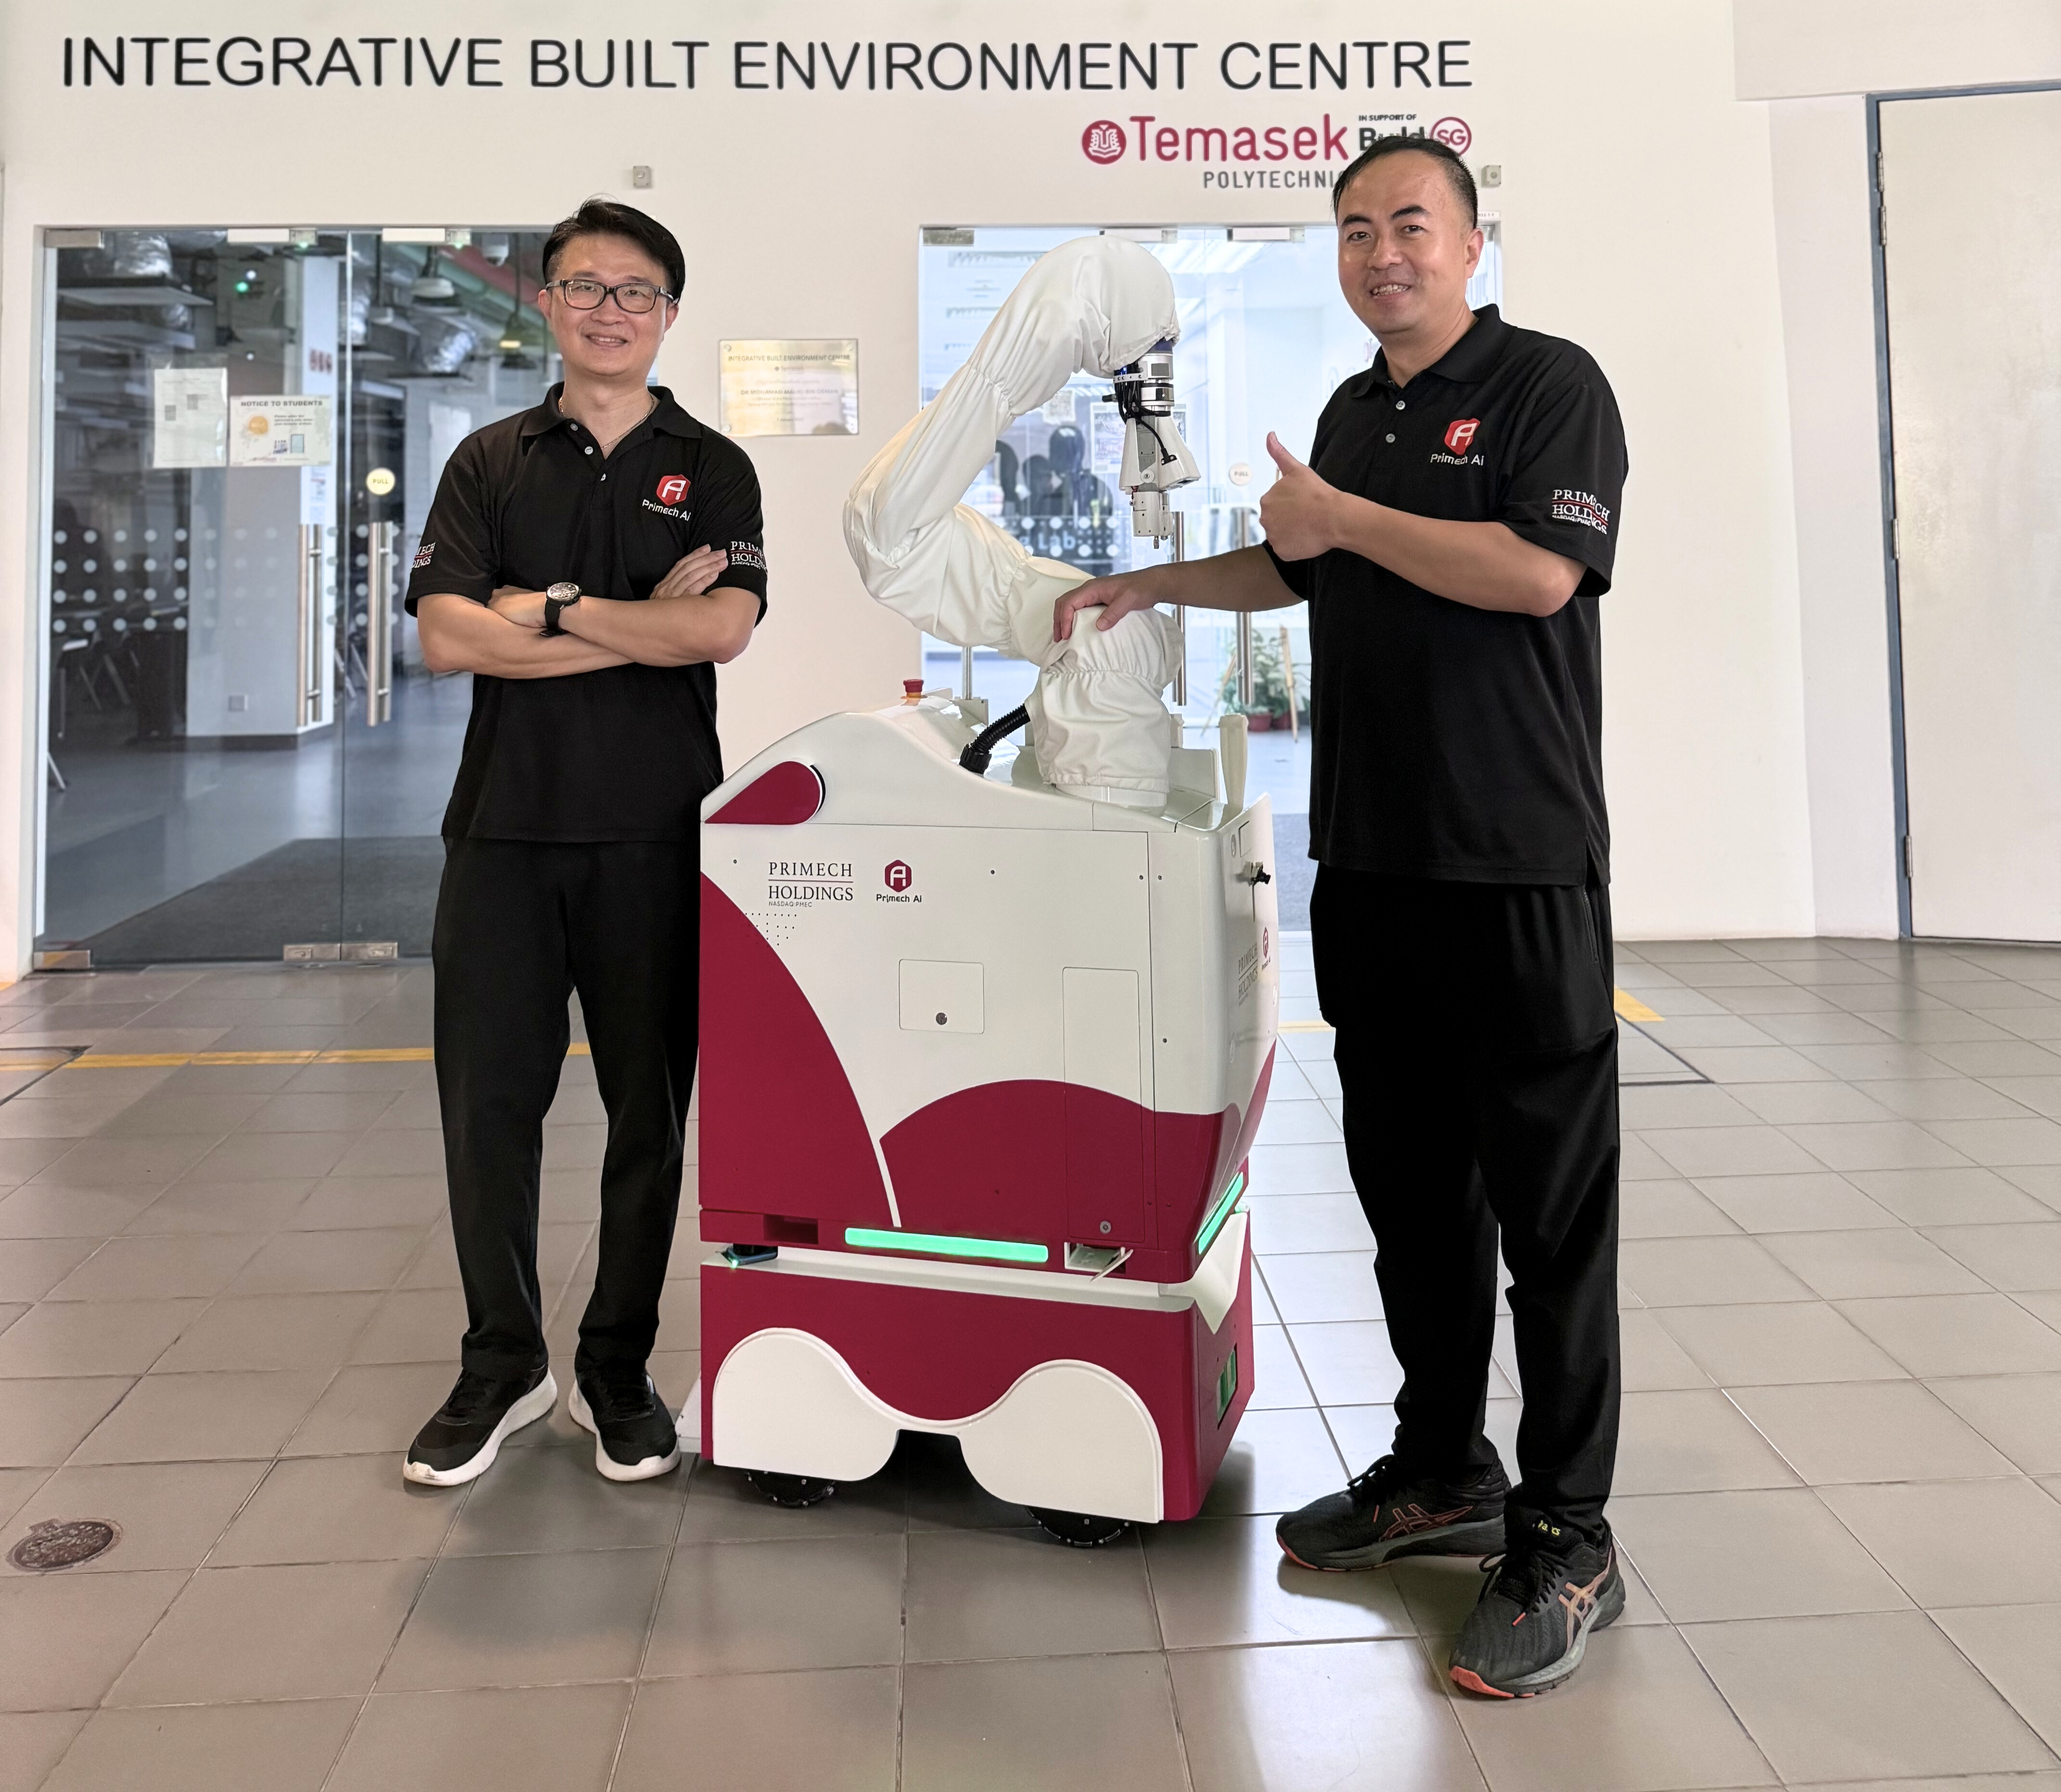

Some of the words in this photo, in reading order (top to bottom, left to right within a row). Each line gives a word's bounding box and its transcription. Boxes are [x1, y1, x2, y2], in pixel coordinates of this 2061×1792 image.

[64, 36, 503, 87] INTEGRATIVE
[531, 38, 710, 89] BUILT
[734, 41, 1198, 90] ENVIRONMENT
[1221, 40, 1472, 90] CENTRE
[1129, 114, 1349, 162] Temasek
[1437, 128, 1466, 146] SG
[1203, 170, 1346, 189] POLYTECHNI
[642, 499, 679, 517] Primech
[1552, 504, 1607, 535] HOLDNGS
[730, 541, 763, 559] PRIM
[769, 862, 852, 877] PRIMECH
[768, 885, 853, 901] HOLDINGS
[876, 893, 910, 903] Primech
